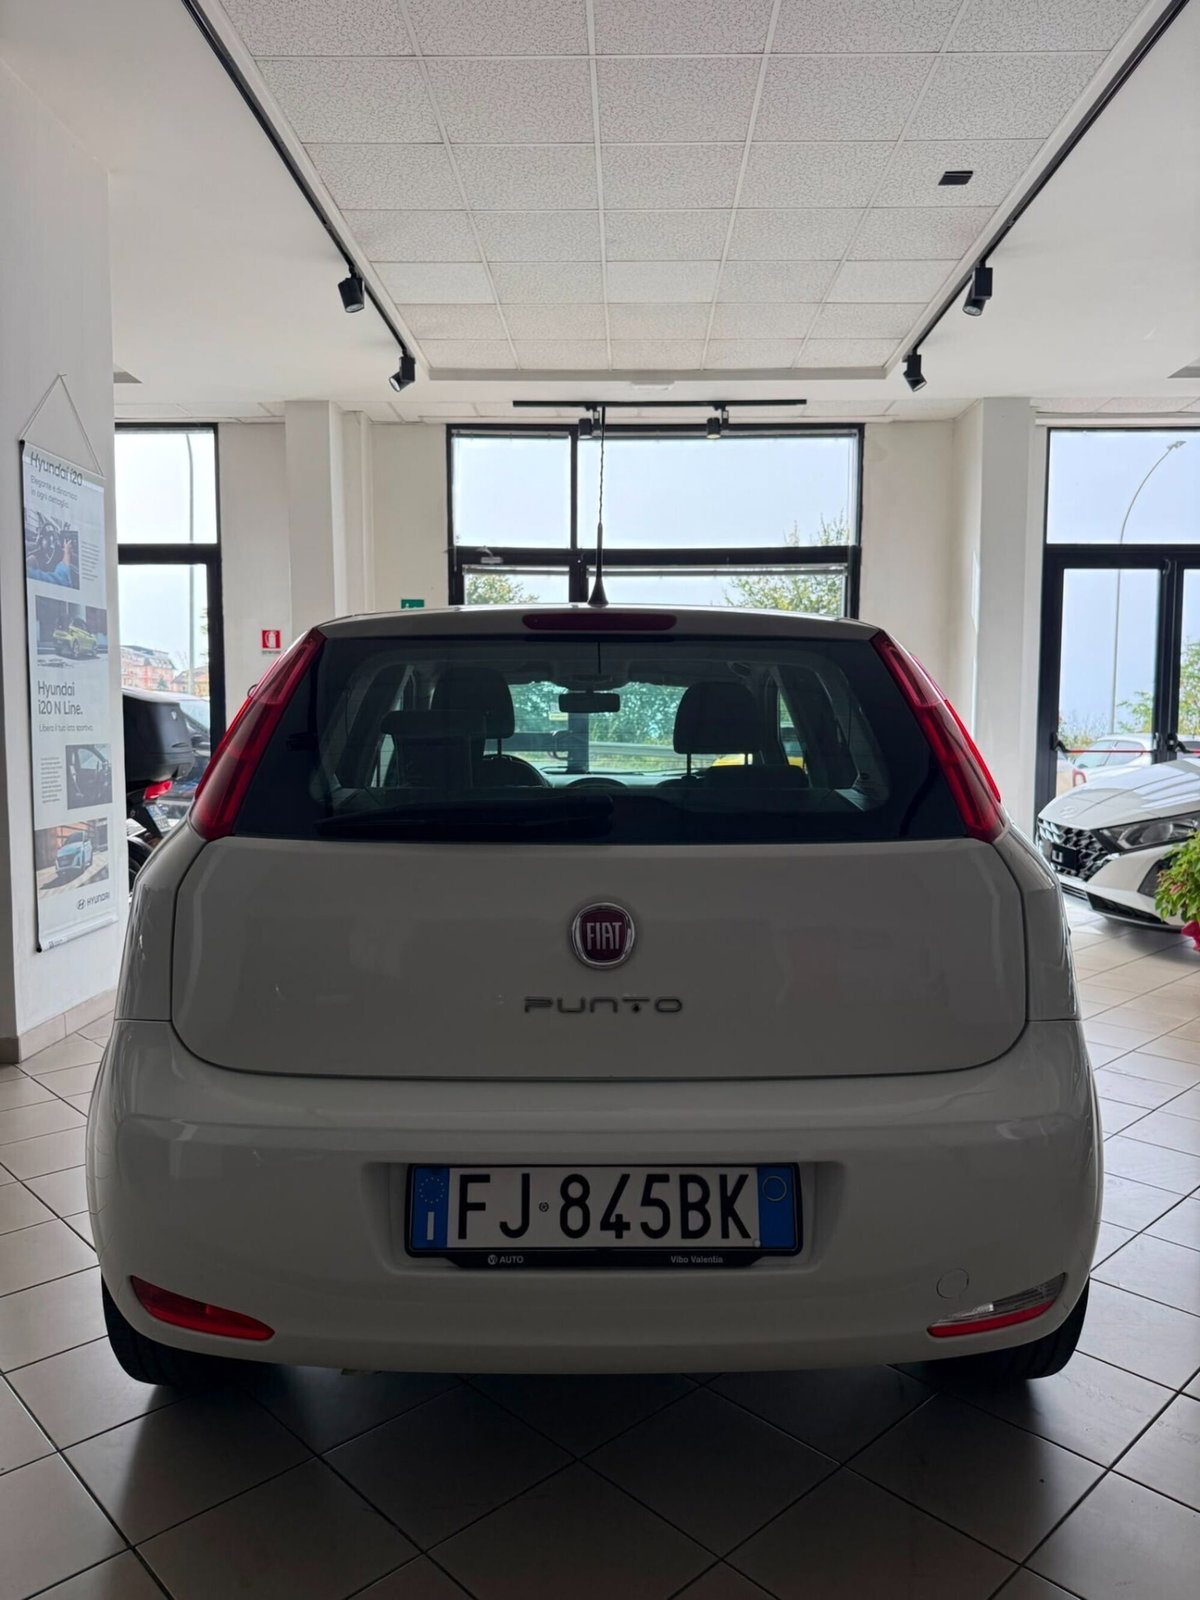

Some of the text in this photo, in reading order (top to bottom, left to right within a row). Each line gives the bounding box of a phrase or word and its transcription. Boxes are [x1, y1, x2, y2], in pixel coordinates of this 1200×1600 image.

[30, 451, 83, 487] Hyundai i20
[37, 680, 75, 698] Hyundai
[38, 700, 83, 715] i20 N Line.
[586, 922, 622, 950] FIAT
[524, 996, 683, 1014] PUNTO
[458, 1173, 530, 1240] FJ
[559, 1173, 752, 1240] 845BK
[499, 1255, 524, 1264] AUTO
[670, 1255, 724, 1264] Vibo Valentia
